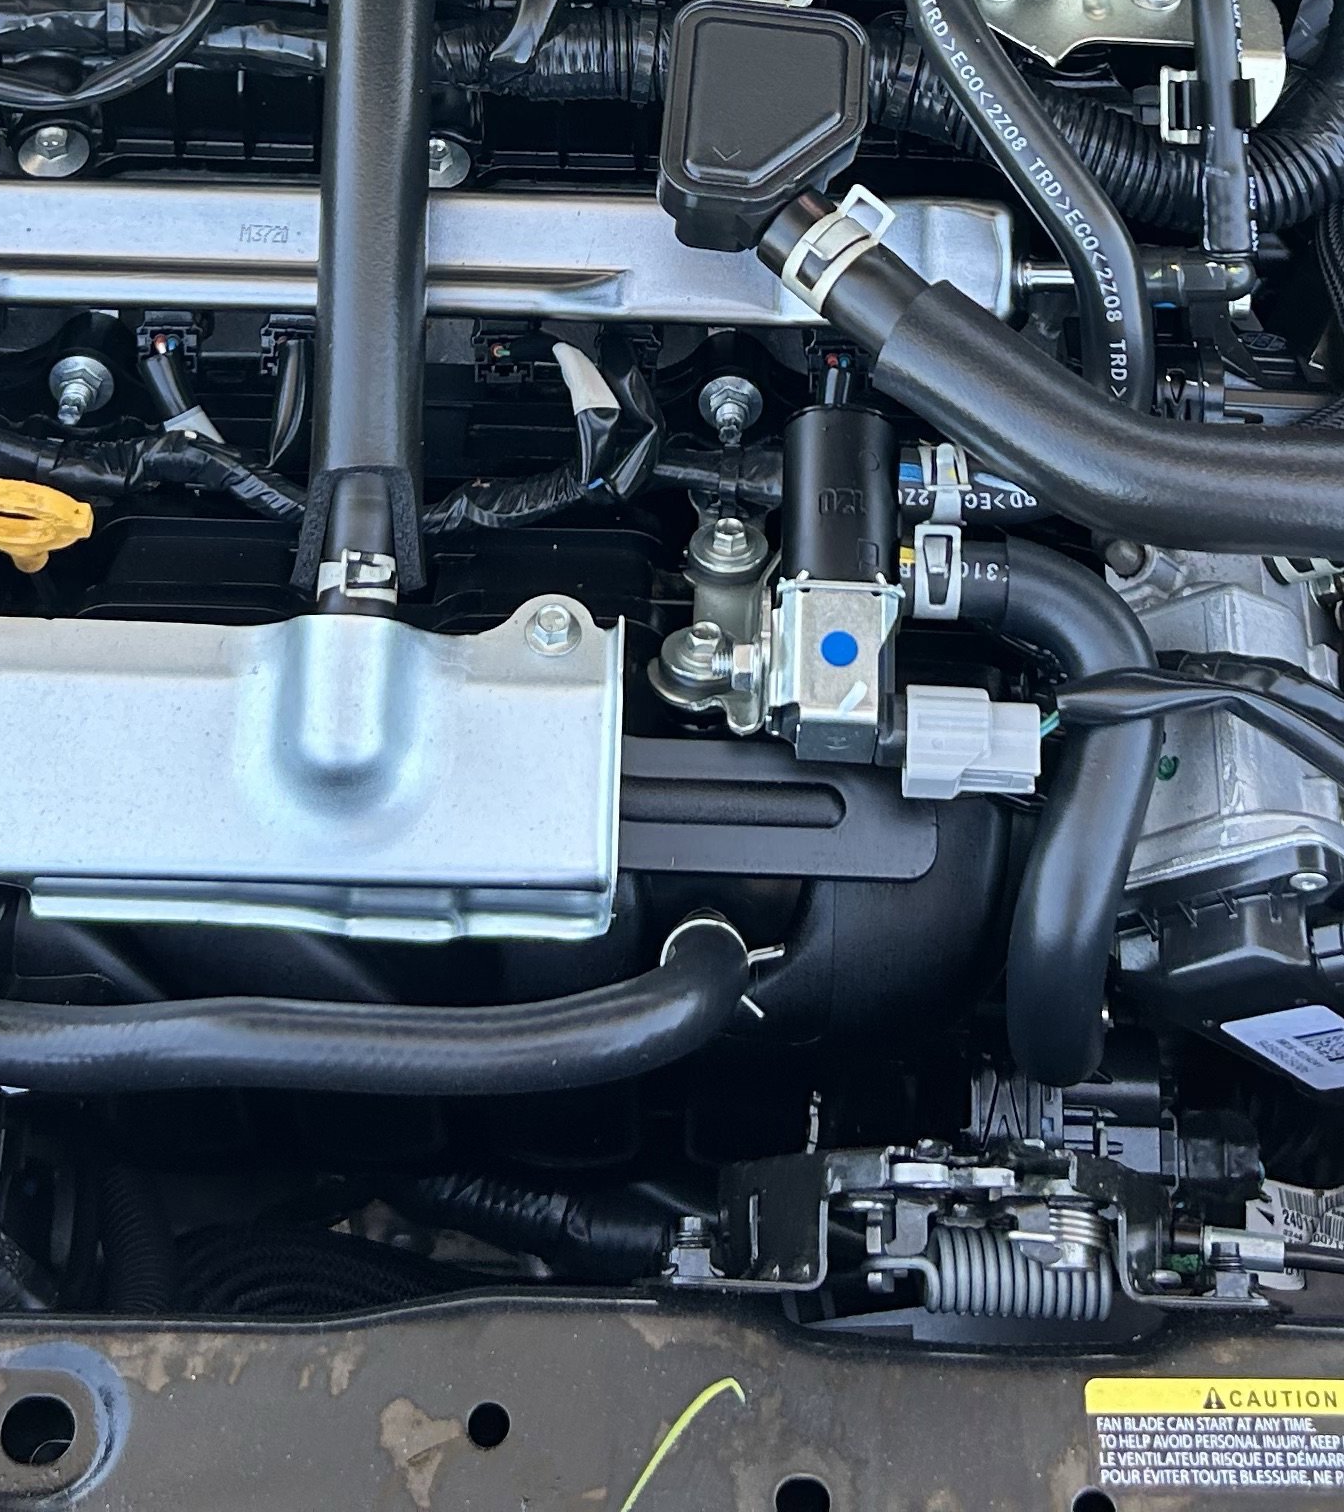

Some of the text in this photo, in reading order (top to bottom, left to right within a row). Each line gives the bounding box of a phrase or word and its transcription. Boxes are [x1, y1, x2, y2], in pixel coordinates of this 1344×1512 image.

[1229, 1390, 1339, 1409] CAUTION
[1096, 1416, 1317, 1432] FAN BLADE CAN START AT ANY TIME.
[1098, 1434, 1117, 1449] TO
[1119, 1434, 1151, 1449] HELP
[1153, 1434, 1193, 1449] AVOID
[1195, 1435, 1261, 1449] PERSONAL
[1310, 1435, 1340, 1450] KEEP
[1099, 1451, 1117, 1466] LE
[1118, 1451, 1208, 1467] VENTILATEUR
[1211, 1452, 1262, 1468] RISQUE
[1264, 1452, 1284, 1467] DE
[1101, 1469, 1140, 1484] POUR
[1143, 1466, 1189, 1484] ÉVITER
[1190, 1469, 1238, 1485] TOUTE
[1239, 1470, 1311, 1487] BLESSURE,
[1313, 1471, 1332, 1486] NE
